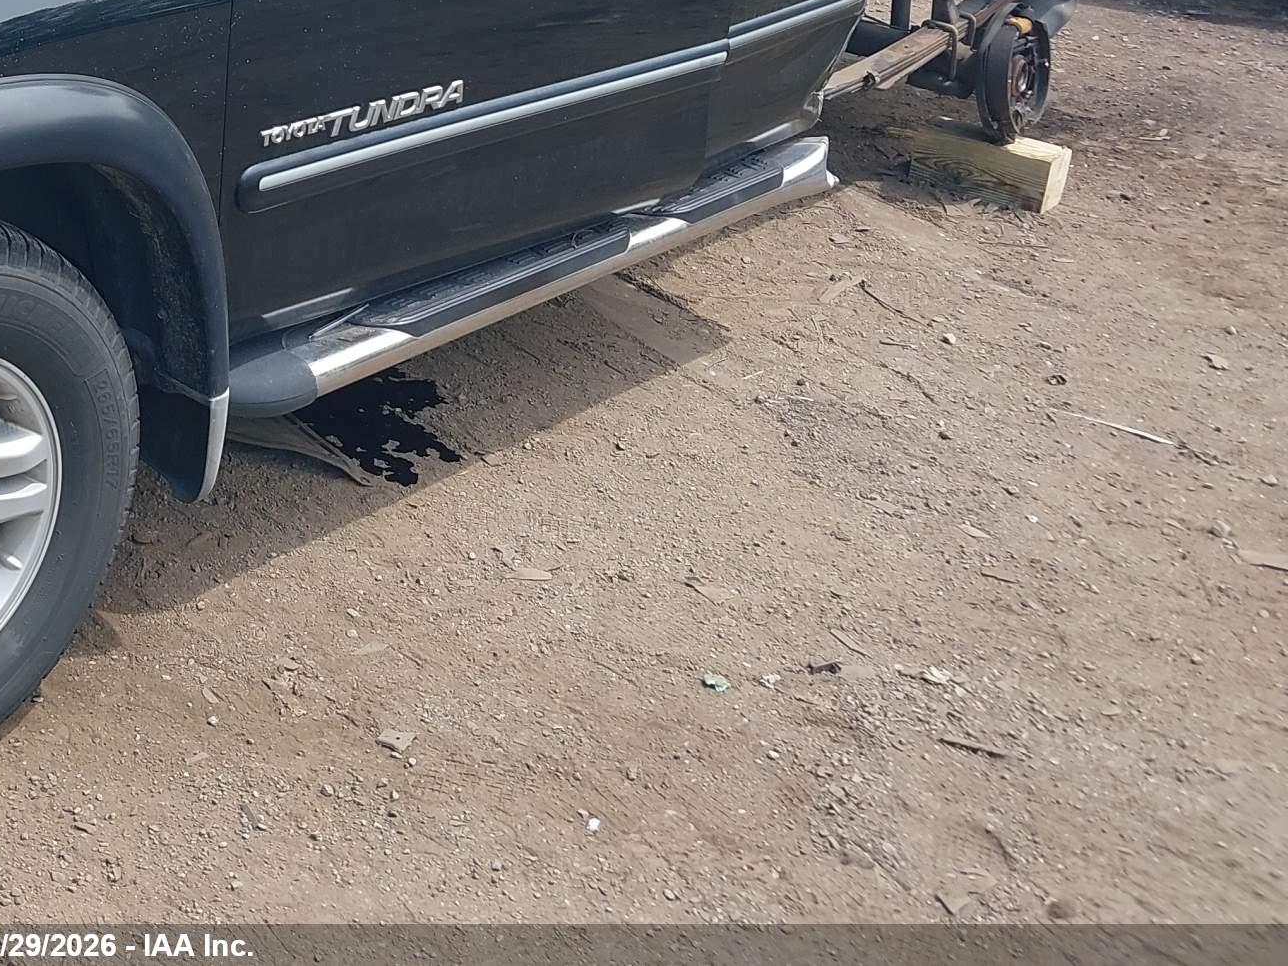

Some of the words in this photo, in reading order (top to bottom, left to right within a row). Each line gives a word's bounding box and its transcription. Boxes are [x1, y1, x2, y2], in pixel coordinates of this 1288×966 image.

[260, 116, 327, 147] TOYOTA
[324, 80, 464, 138] TUNDRA
[93, 378, 120, 491] 265/65R17
